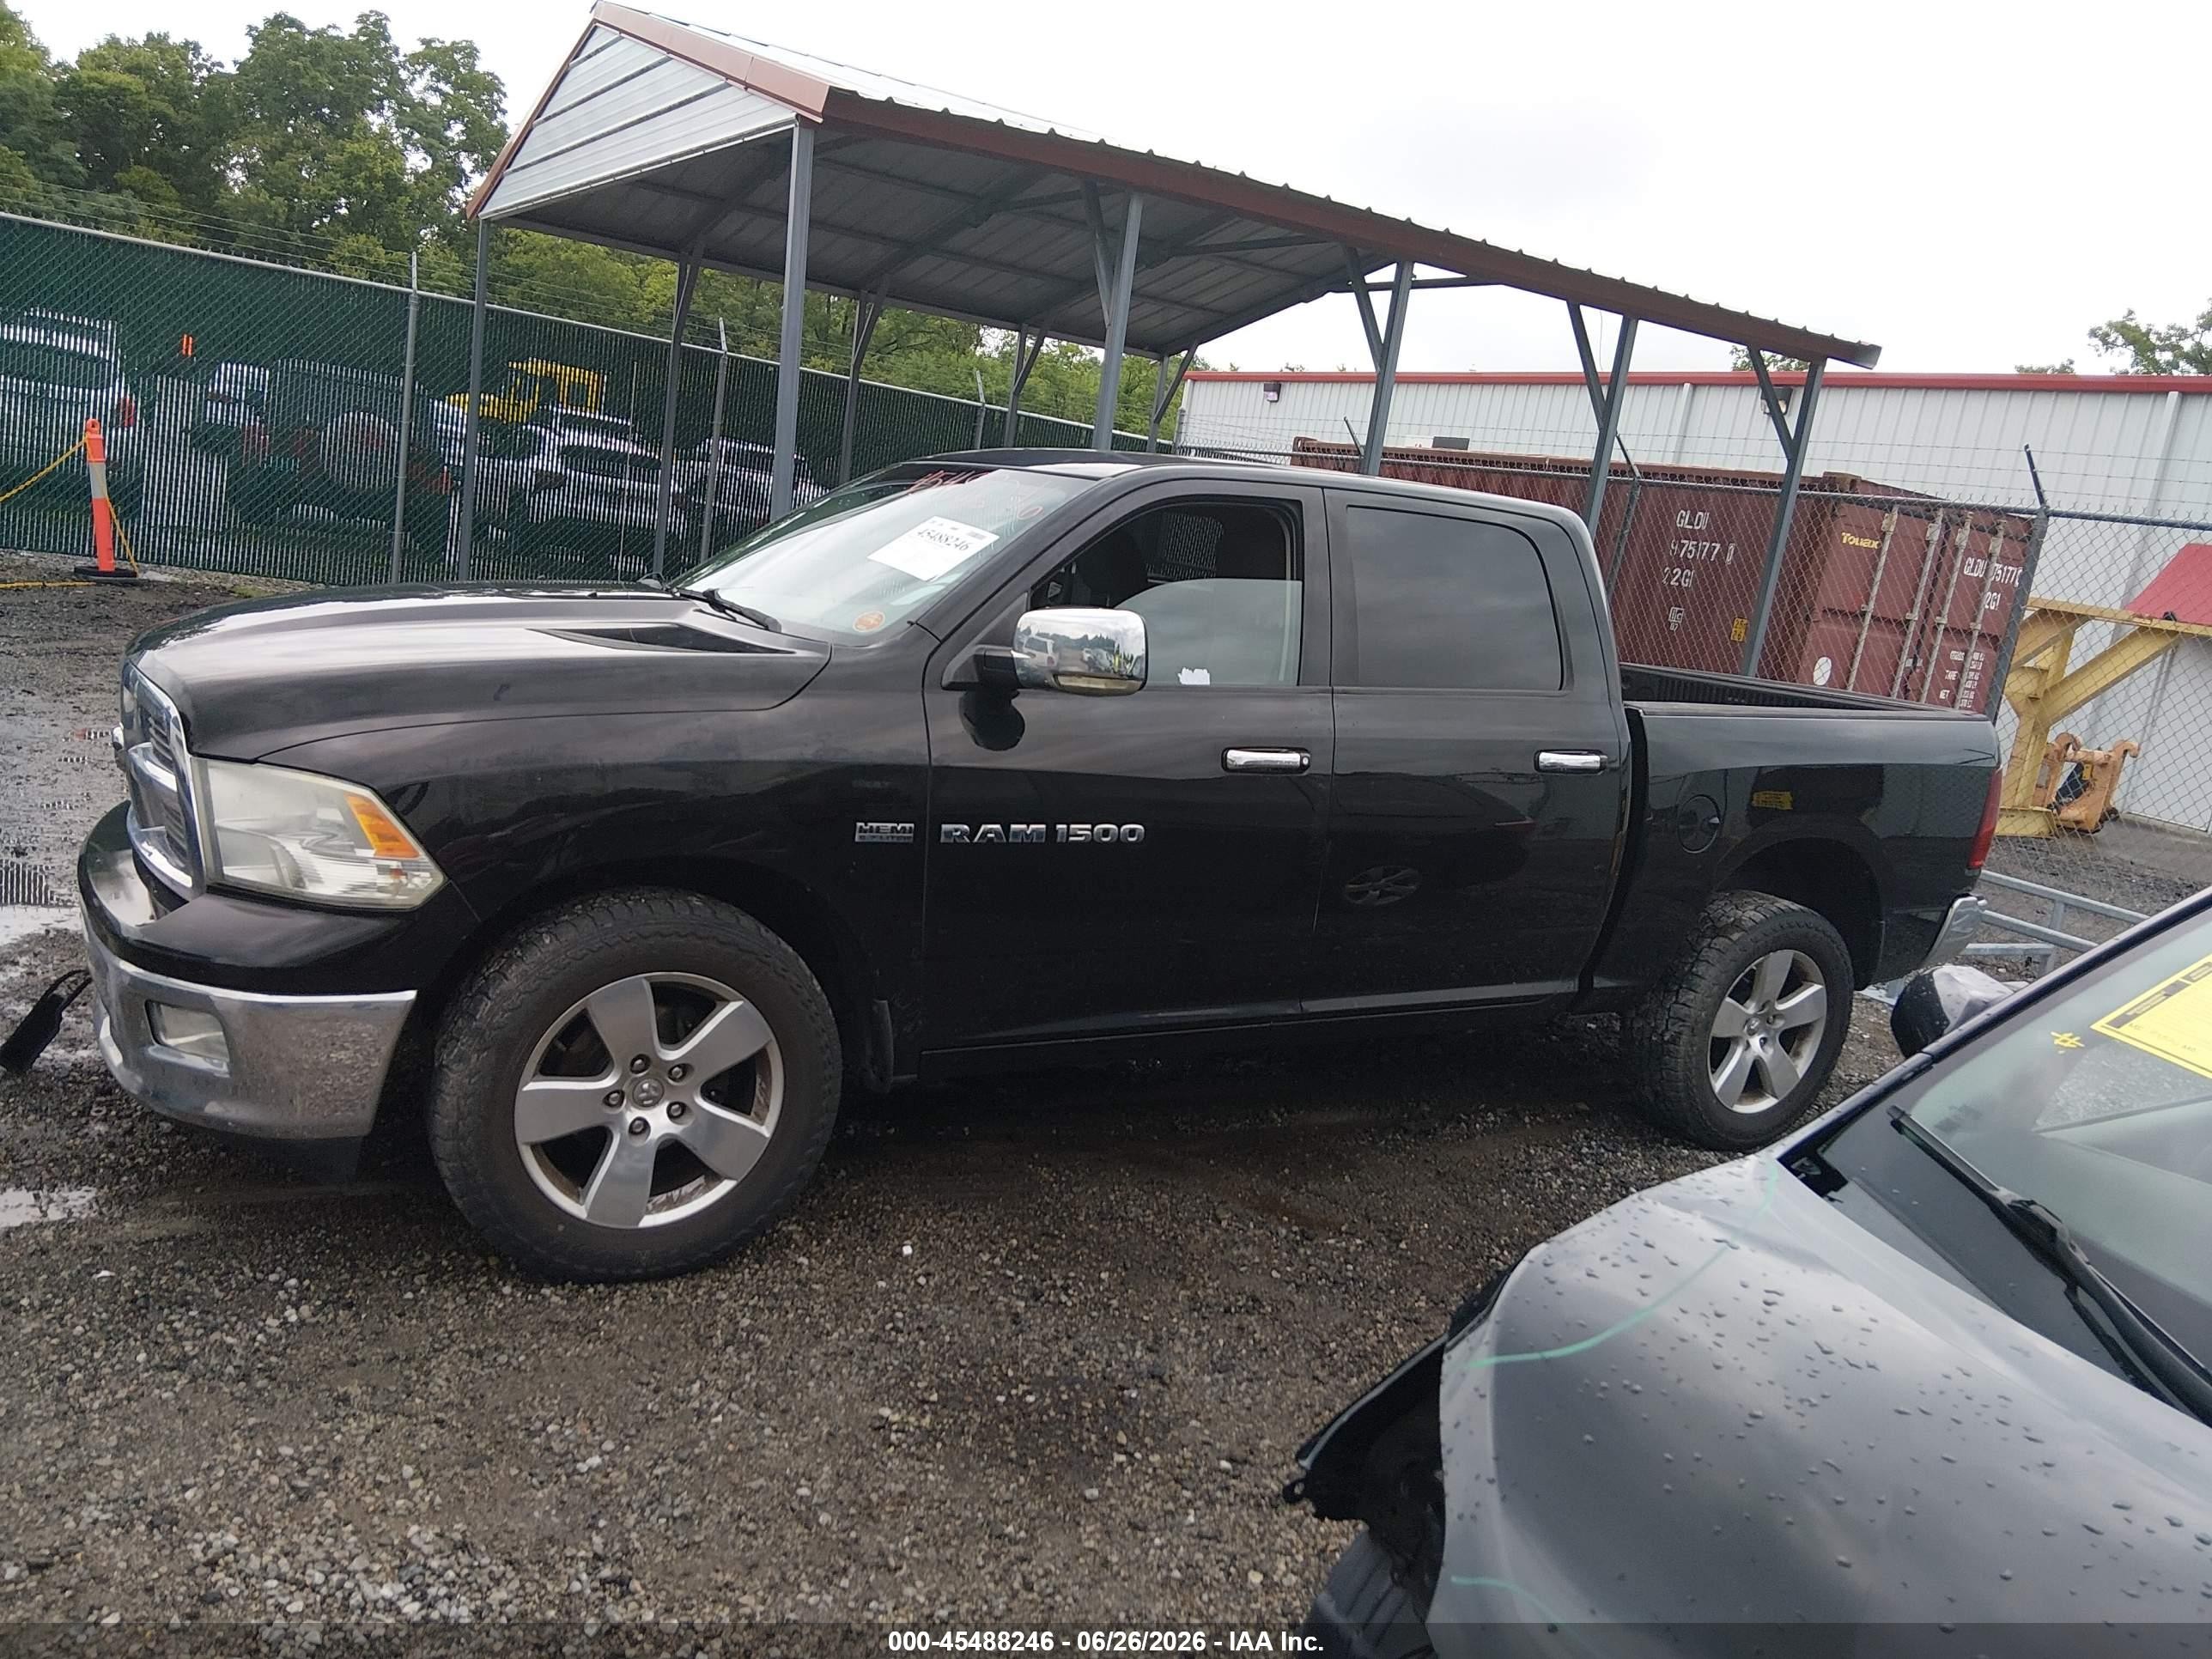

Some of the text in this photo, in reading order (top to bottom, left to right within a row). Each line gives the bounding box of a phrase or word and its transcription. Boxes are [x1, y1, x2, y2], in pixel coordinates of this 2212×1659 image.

[857, 822, 914, 834] HEMI
[940, 823, 1146, 843] RAM 1500
